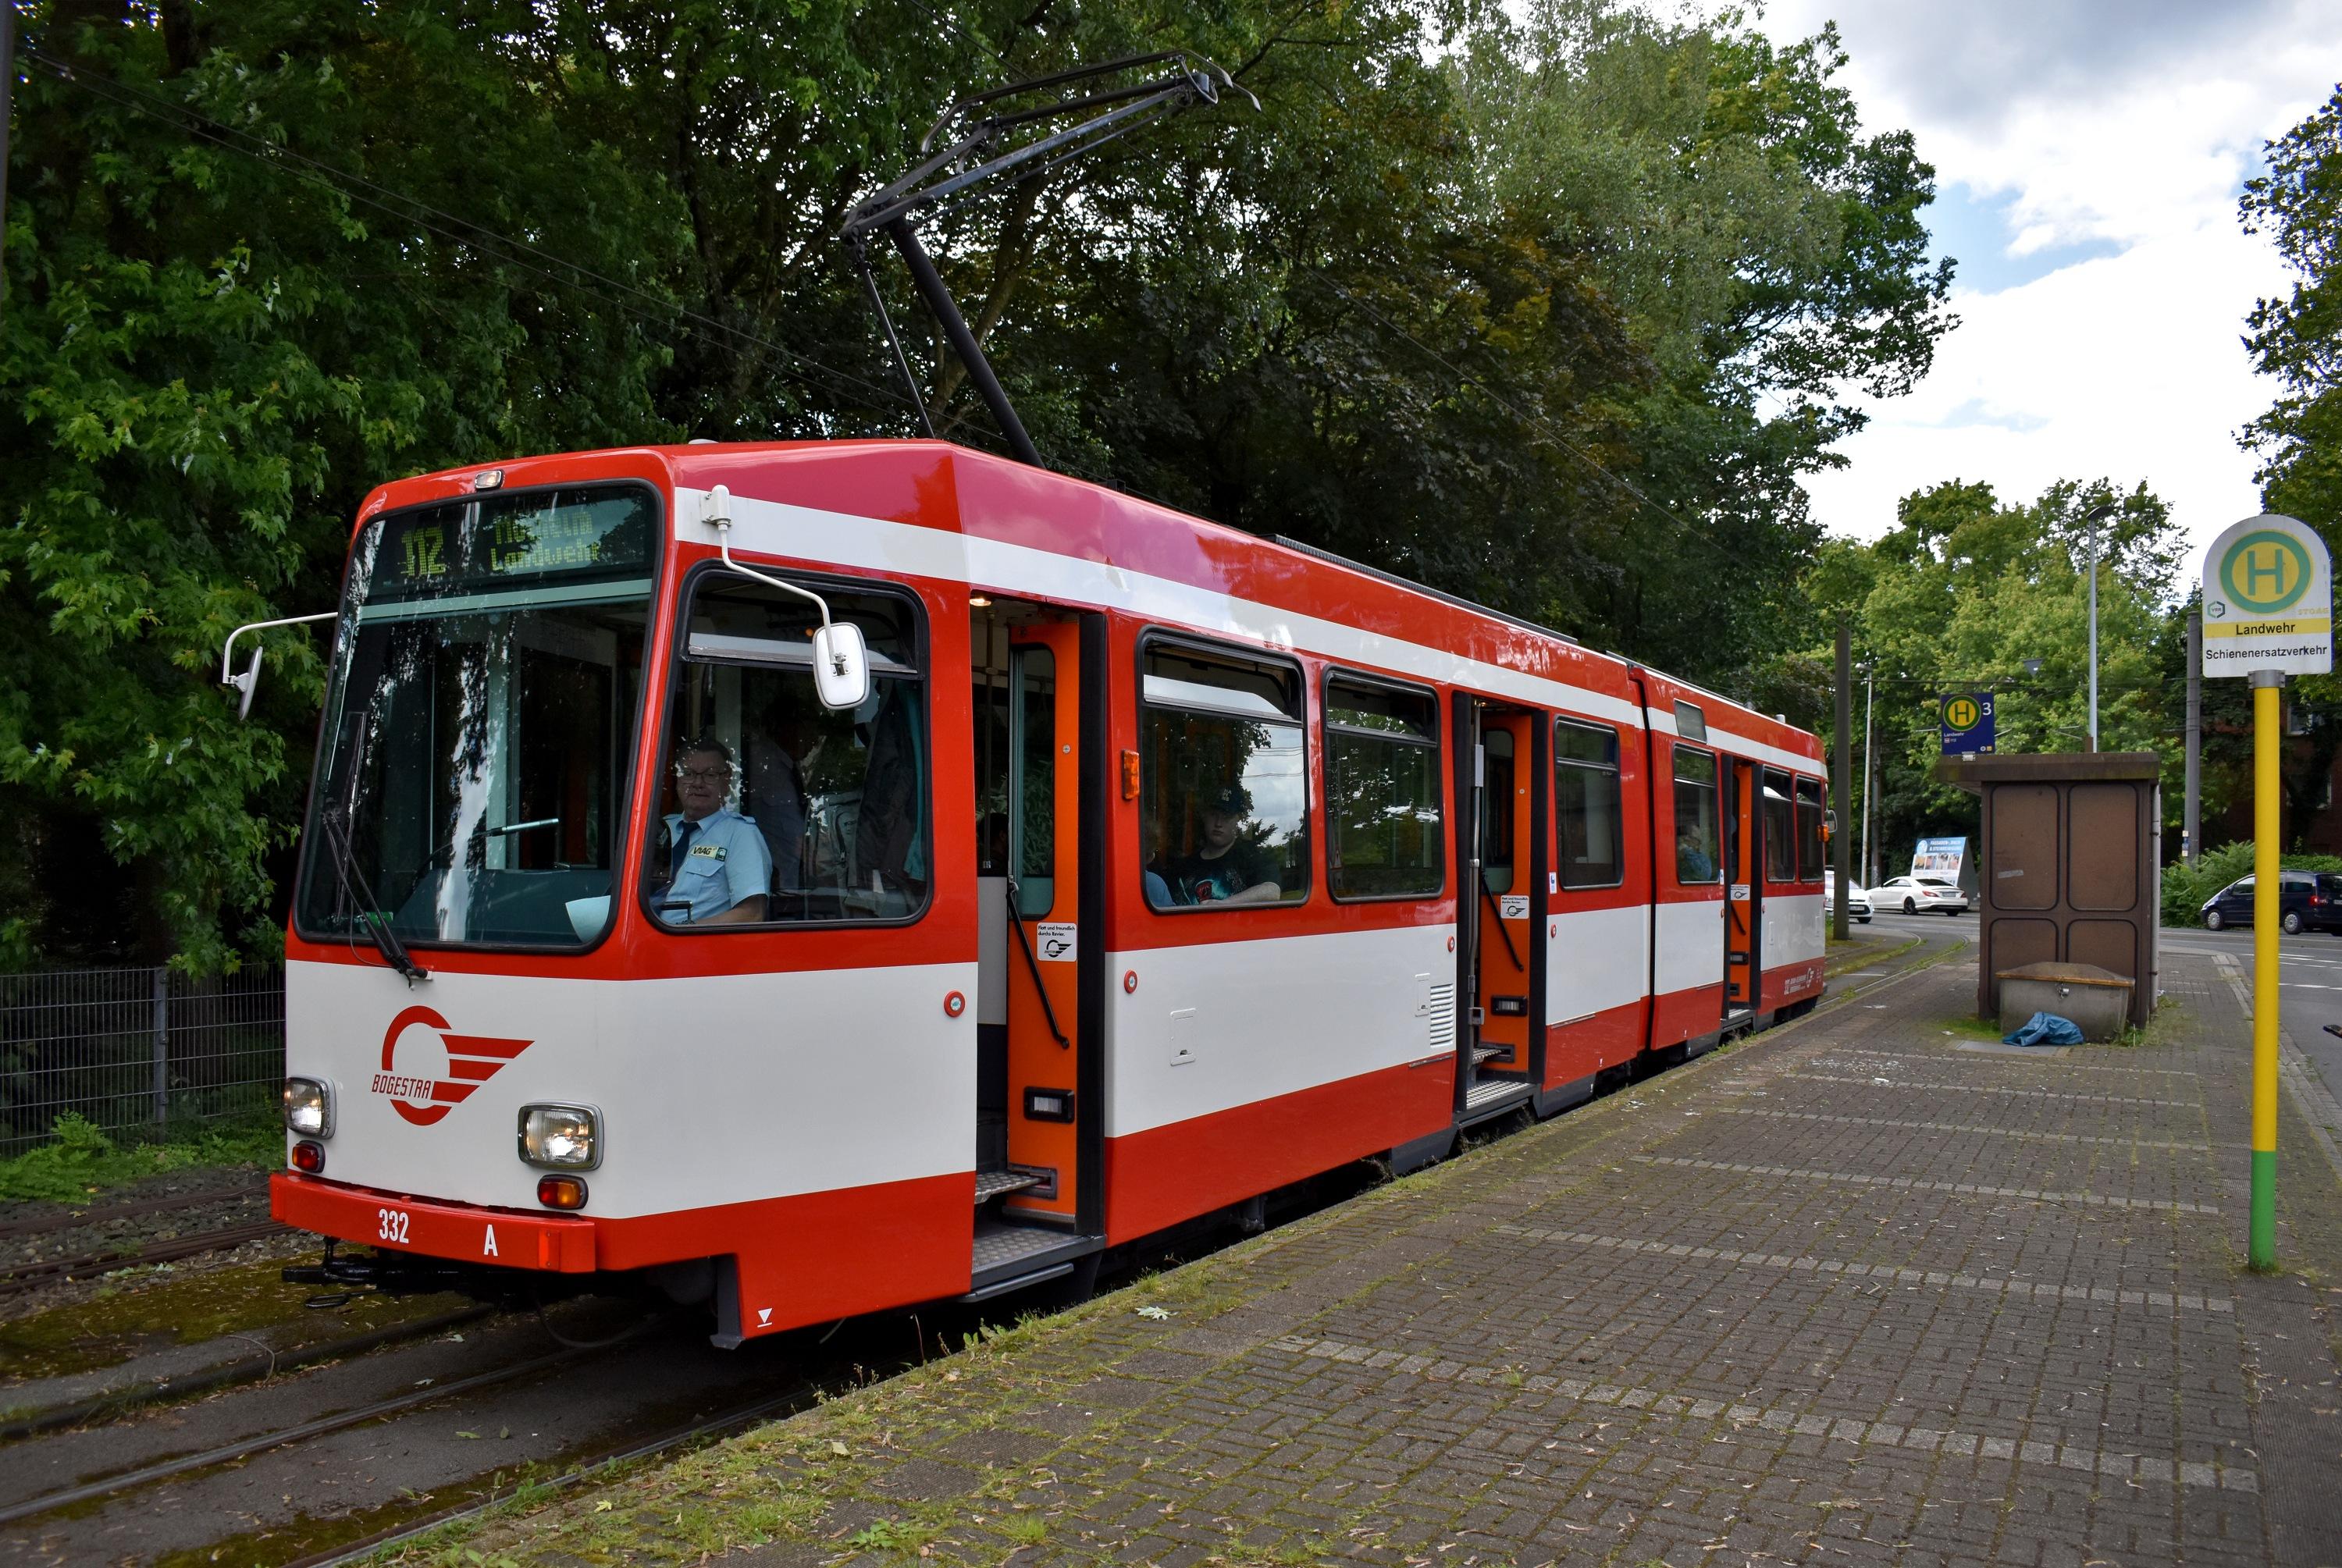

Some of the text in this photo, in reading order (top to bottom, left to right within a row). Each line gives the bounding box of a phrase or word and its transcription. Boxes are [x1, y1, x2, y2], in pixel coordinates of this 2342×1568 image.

[400, 527, 447, 576] 112
[490, 539, 600, 571] Landwehr
[2247, 549, 2283, 596] H
[2236, 622, 2295, 635] Landwehr
[2206, 645, 2327, 660] Schienenersatzverkehr
[1955, 703, 1970, 723] H
[1982, 702, 1991, 716] 3
[372, 1074, 431, 1099] BOGESTRA
[379, 1208, 409, 1244] 332
[483, 1224, 498, 1257] A
